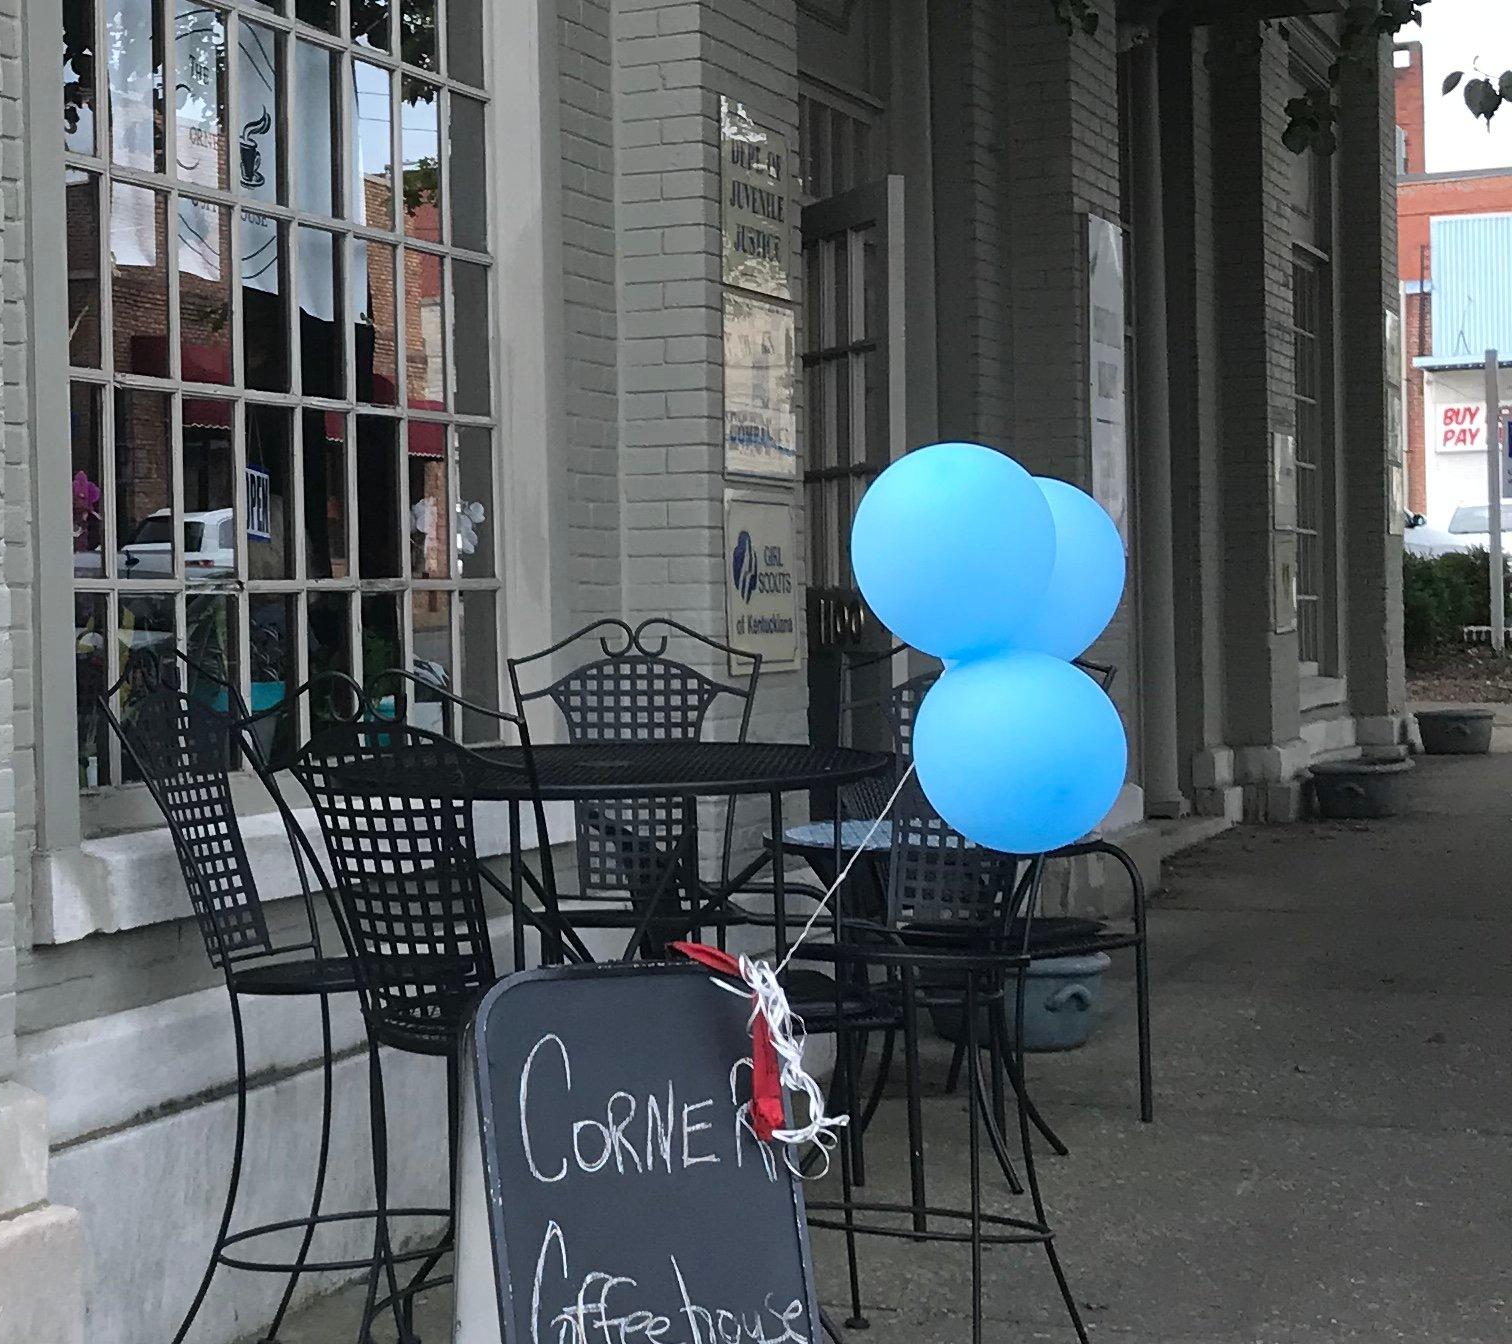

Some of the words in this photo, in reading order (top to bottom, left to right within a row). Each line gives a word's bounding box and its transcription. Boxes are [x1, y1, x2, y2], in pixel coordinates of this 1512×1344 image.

[188, 54, 210, 86] THE
[729, 180, 785, 223] JUVENILE
[734, 223, 782, 263] JUSTICE
[1443, 406, 1480, 426] BUY
[1443, 427, 1480, 447] PAY
[246, 469, 269, 533] PEN
[763, 545, 784, 567] GIRL
[758, 572, 792, 594] SCOUTS
[736, 613, 745, 635] of
[520, 1033, 778, 1183] CORNER
